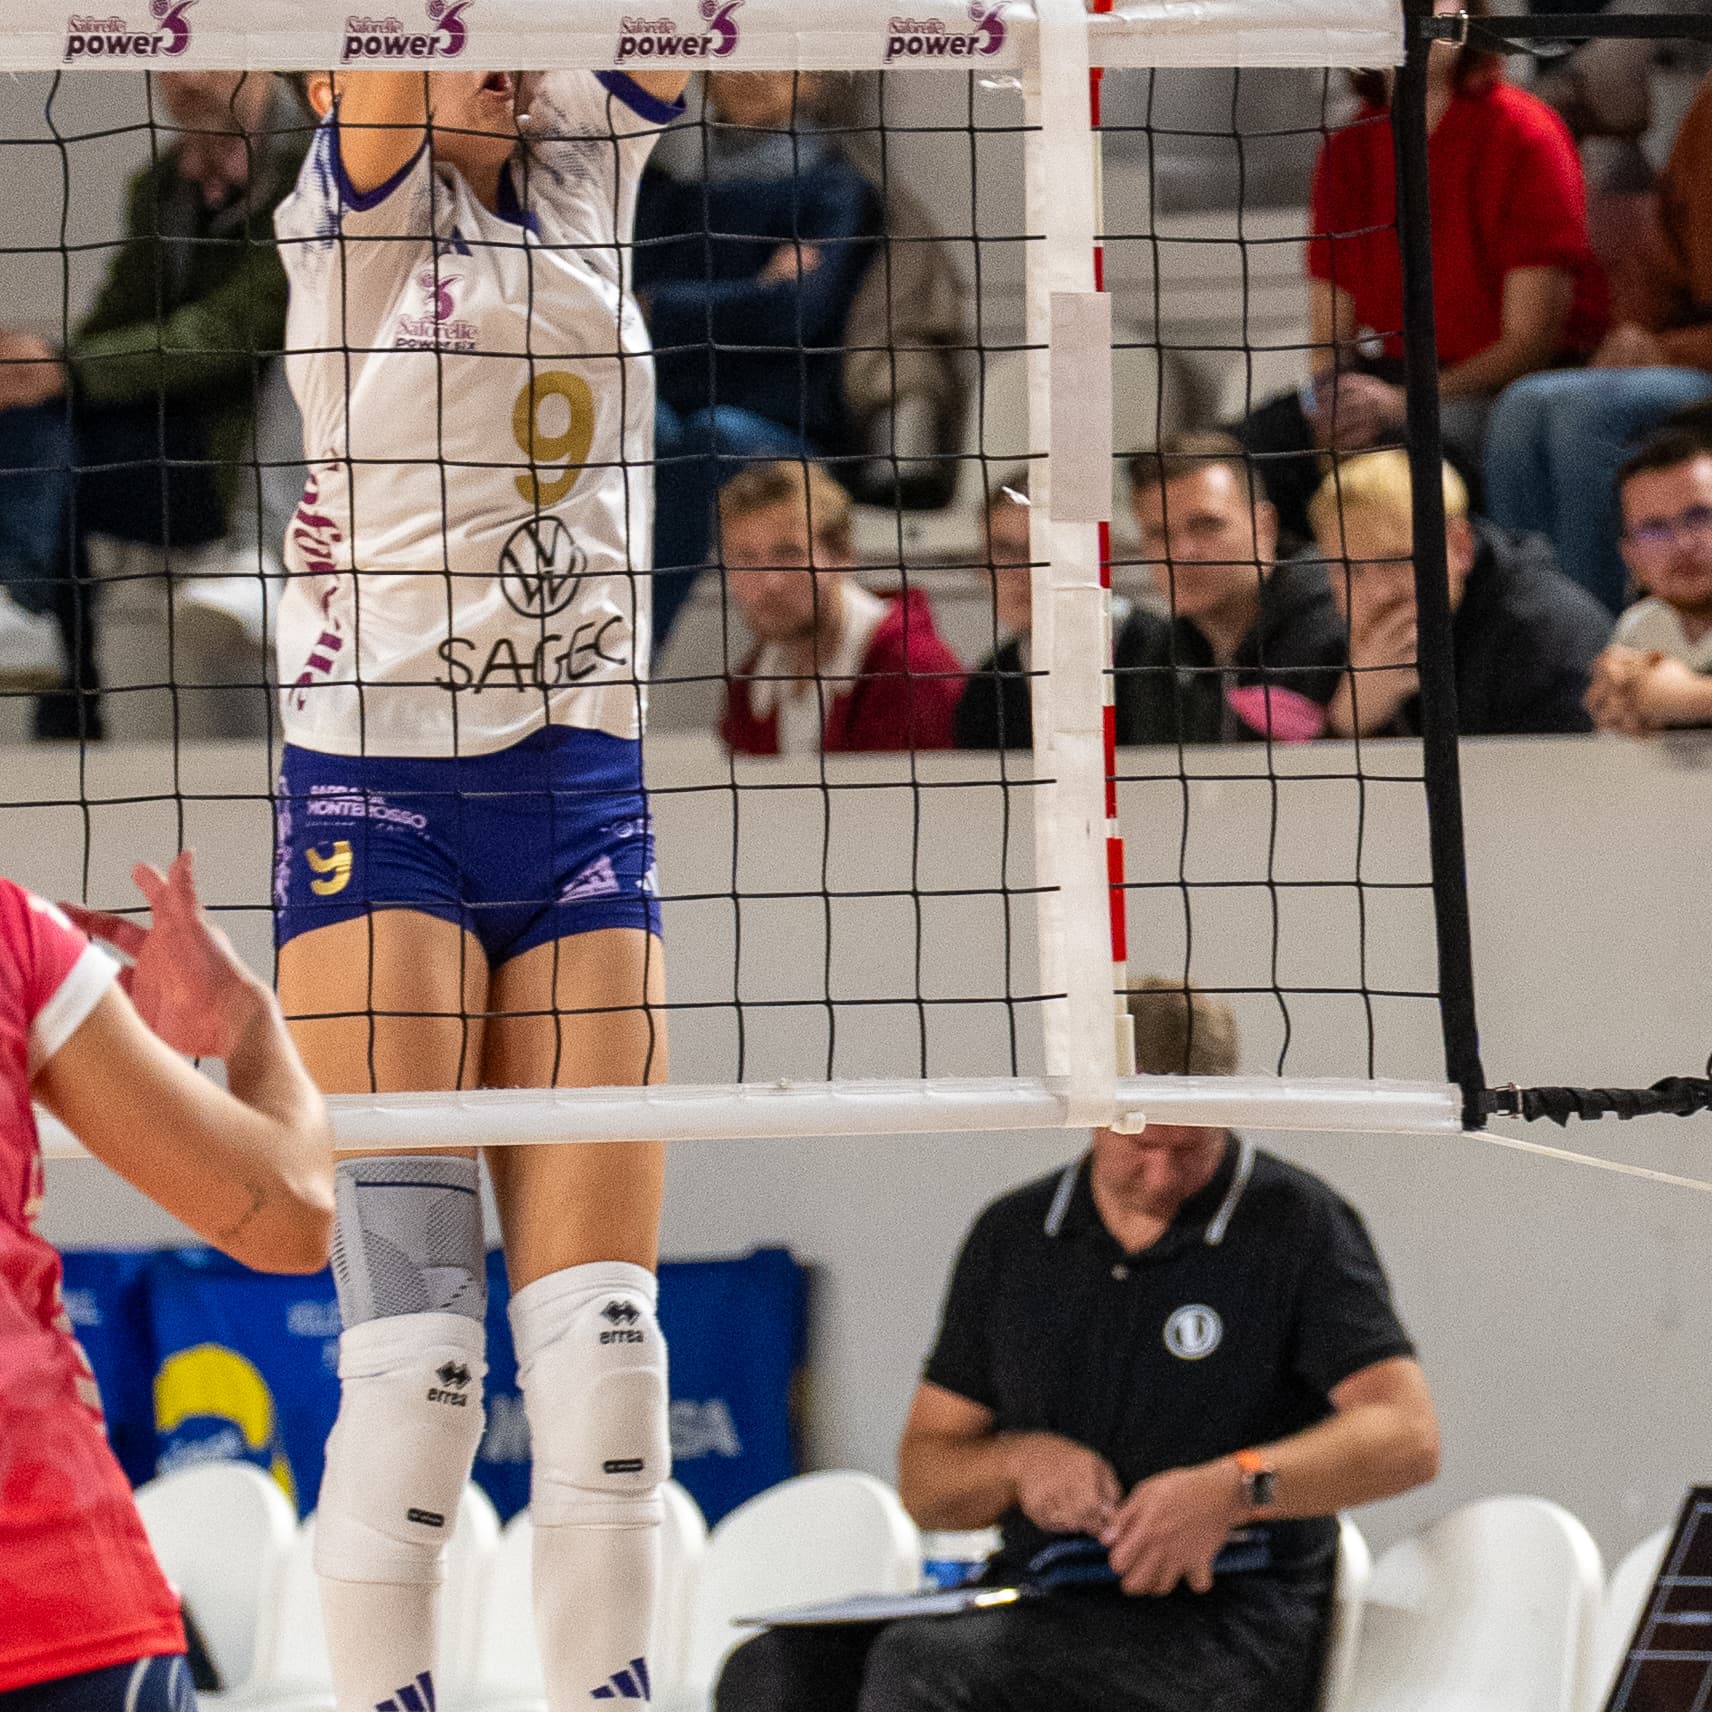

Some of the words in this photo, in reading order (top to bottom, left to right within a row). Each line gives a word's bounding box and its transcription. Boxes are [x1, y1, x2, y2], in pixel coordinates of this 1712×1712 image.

[66, 33, 163, 60] power
[343, 33, 441, 60] power
[616, 34, 714, 61] power
[885, 34, 981, 61] power
[512, 370, 595, 506] 9
[436, 615, 627, 694] SAGEC
